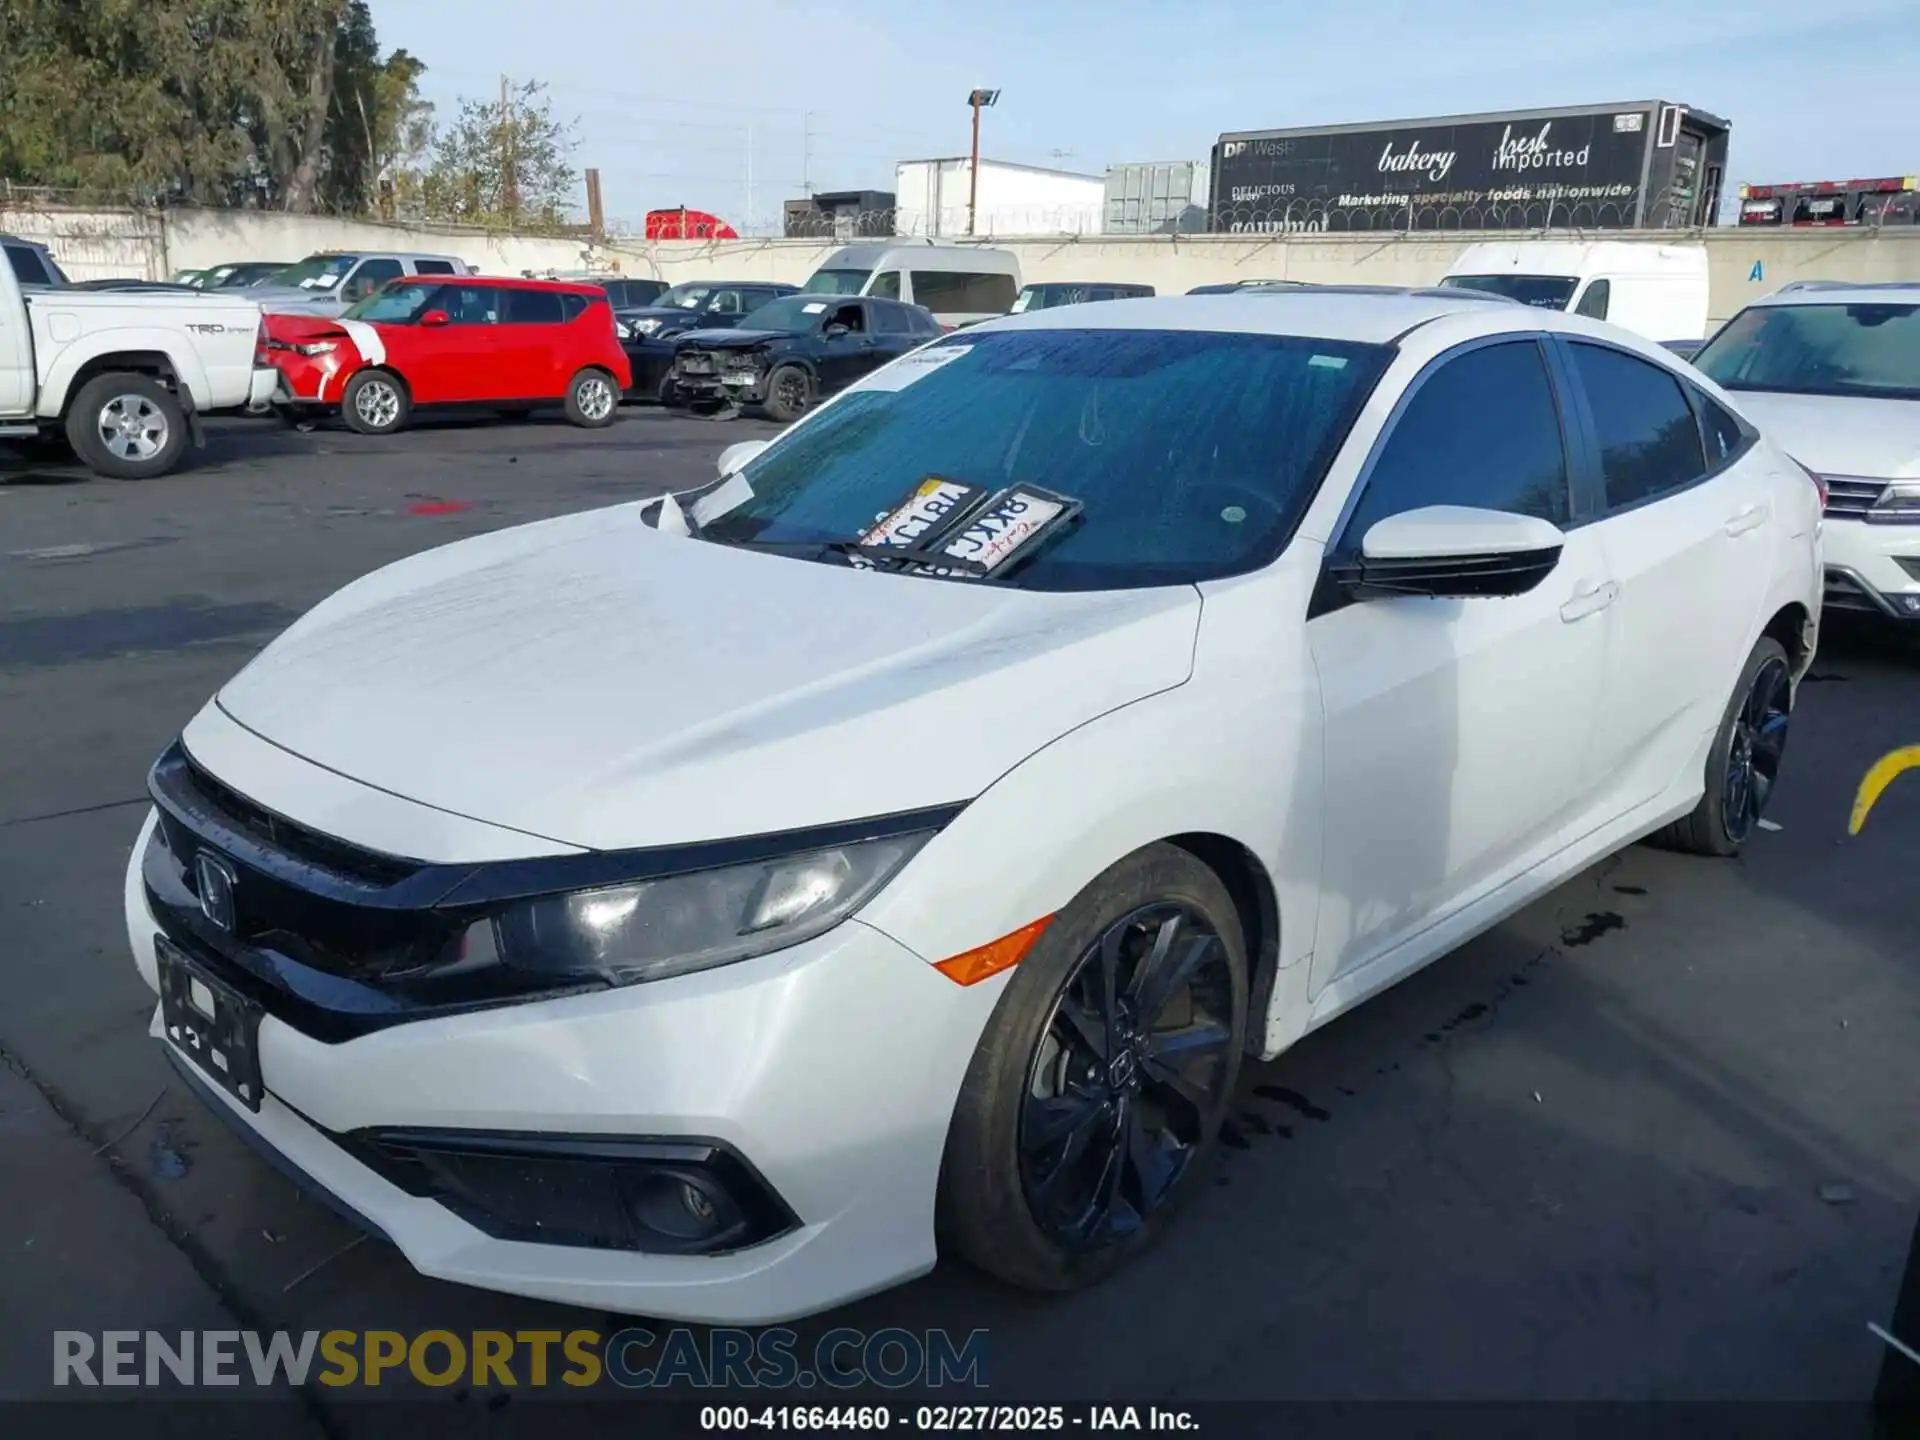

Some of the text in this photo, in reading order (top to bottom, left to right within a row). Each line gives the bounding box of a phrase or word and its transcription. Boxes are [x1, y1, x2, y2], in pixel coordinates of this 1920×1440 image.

[1378, 140, 1457, 182] bakery
[1491, 144, 1590, 173] imported
[1231, 183, 1296, 198] DELICIOUS
[1338, 192, 1409, 206] Marketing
[1412, 189, 1482, 204] specialty
[1487, 187, 1531, 200] foods
[1535, 182, 1632, 199] nationwide
[1747, 259, 1764, 282] A
[184, 323, 225, 336] TRD
